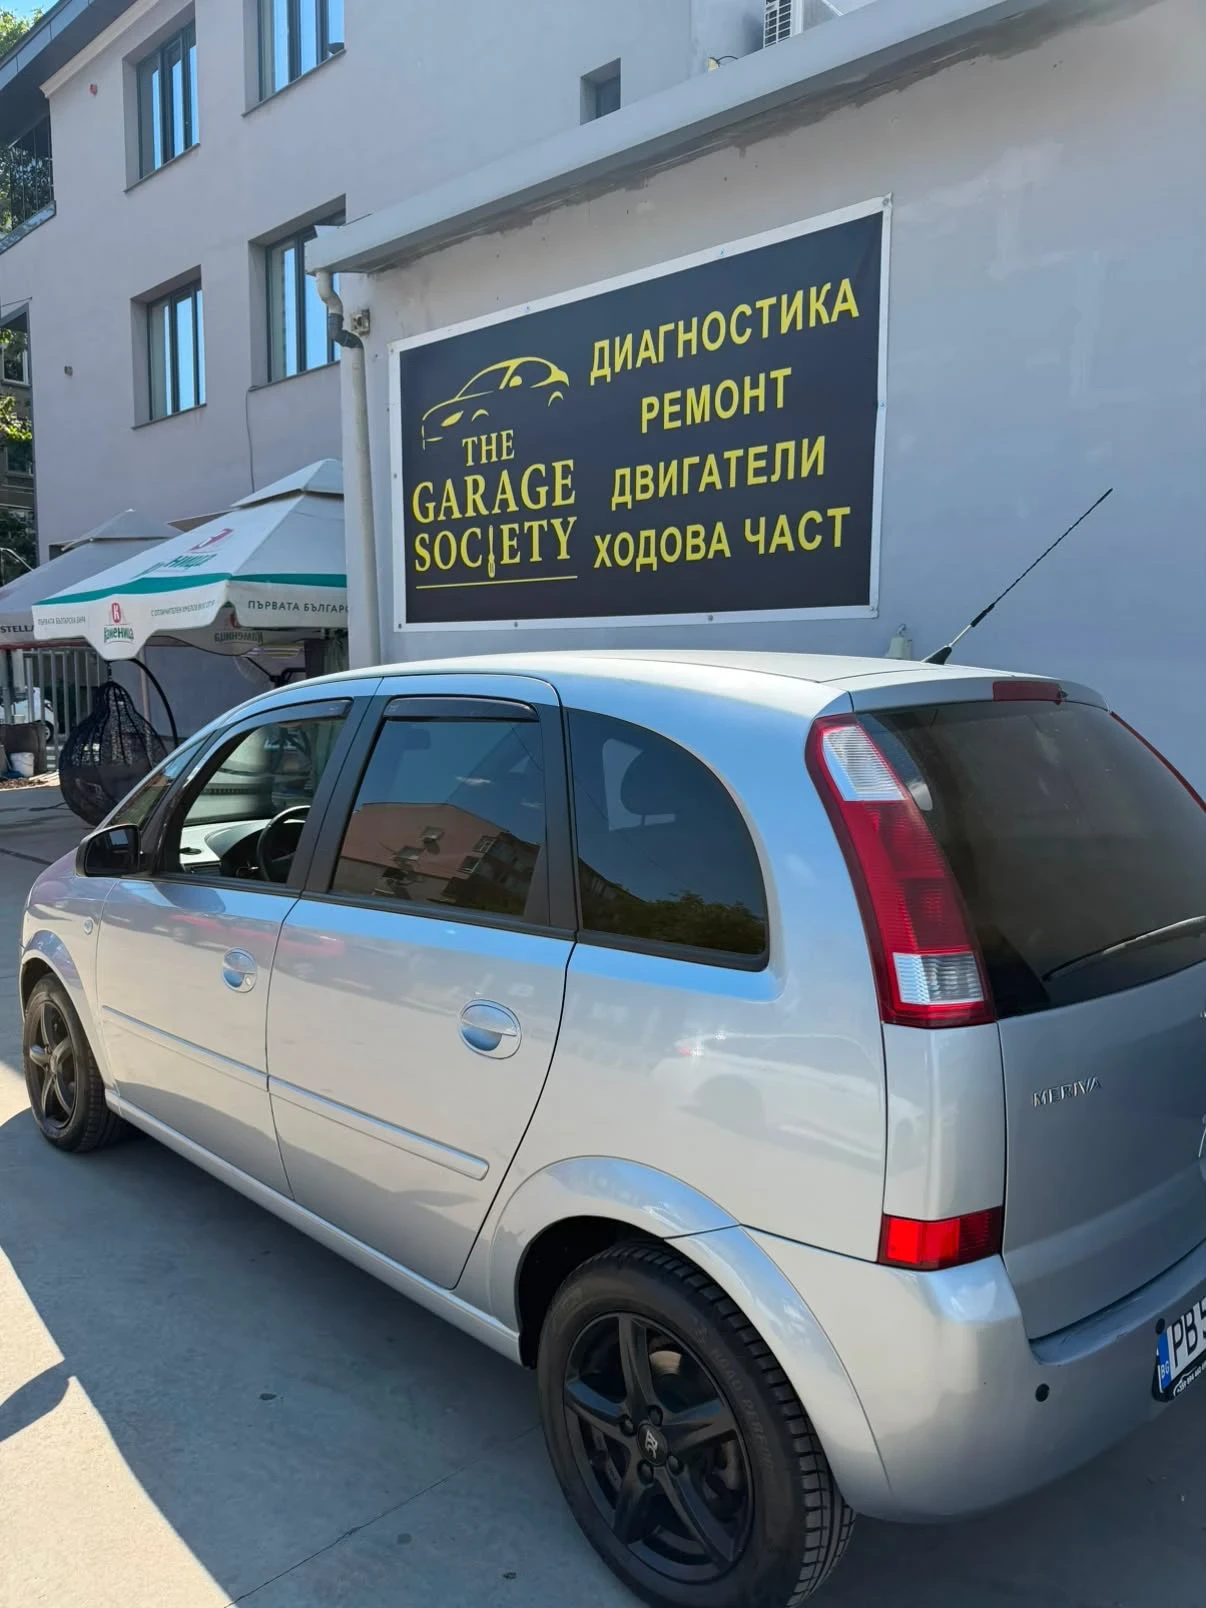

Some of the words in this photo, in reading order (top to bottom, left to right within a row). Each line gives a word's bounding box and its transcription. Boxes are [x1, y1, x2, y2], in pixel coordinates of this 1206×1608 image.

[589, 278, 860, 386] ДИАГНОСТИКА
[641, 367, 793, 434] РЕМОНТ
[462, 430, 514, 467] THE
[610, 435, 826, 511] ДВИГАТЕЛИ
[411, 459, 576, 524] GARAGE
[413, 516, 578, 576] SOCIETY
[593, 521, 731, 573] ХОДОВА
[743, 506, 852, 556] ЧАСТ
[248, 600, 300, 611] ПЪРВАТА
[1032, 1077, 1102, 1108] MERIVA
[1161, 1361, 1170, 1378] BG
